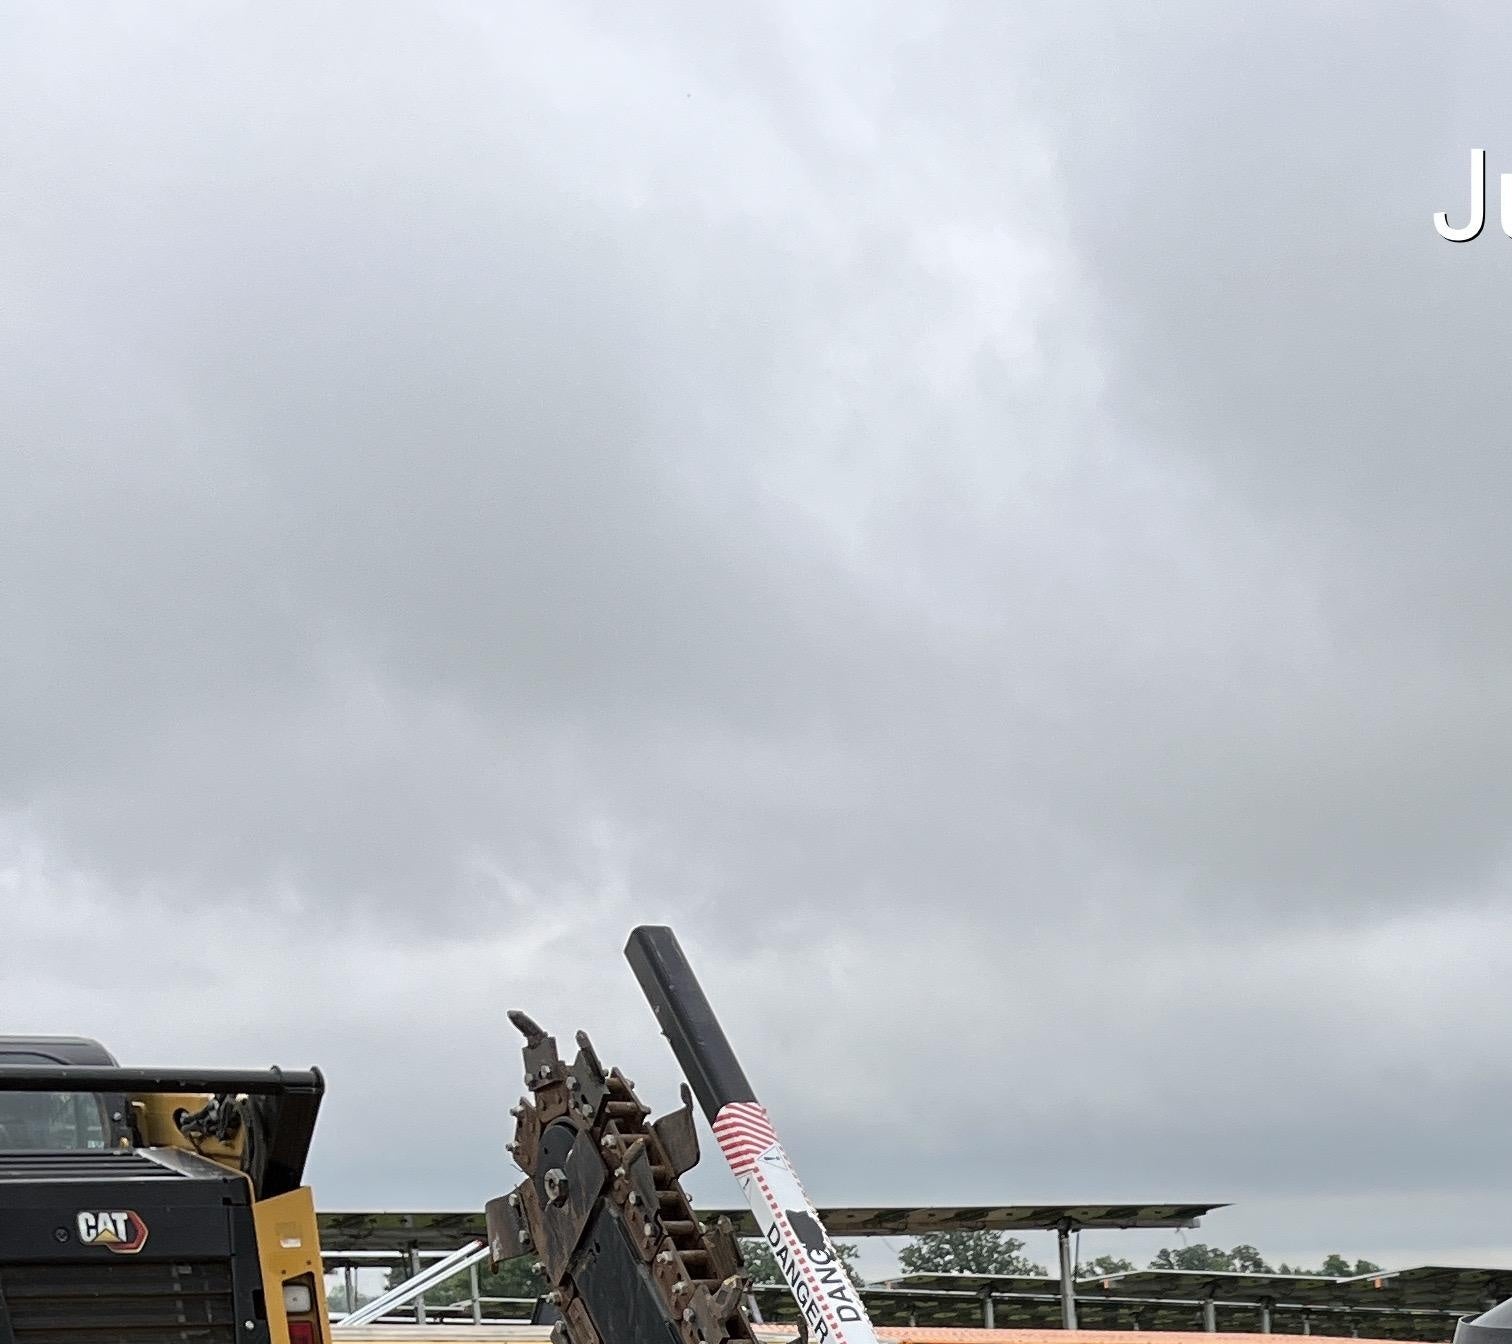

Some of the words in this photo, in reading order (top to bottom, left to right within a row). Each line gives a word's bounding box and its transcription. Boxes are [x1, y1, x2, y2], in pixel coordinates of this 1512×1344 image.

[77, 1211, 129, 1243] CAT
[767, 1222, 829, 1344] DANGER
[807, 1248, 861, 1322] DANG
